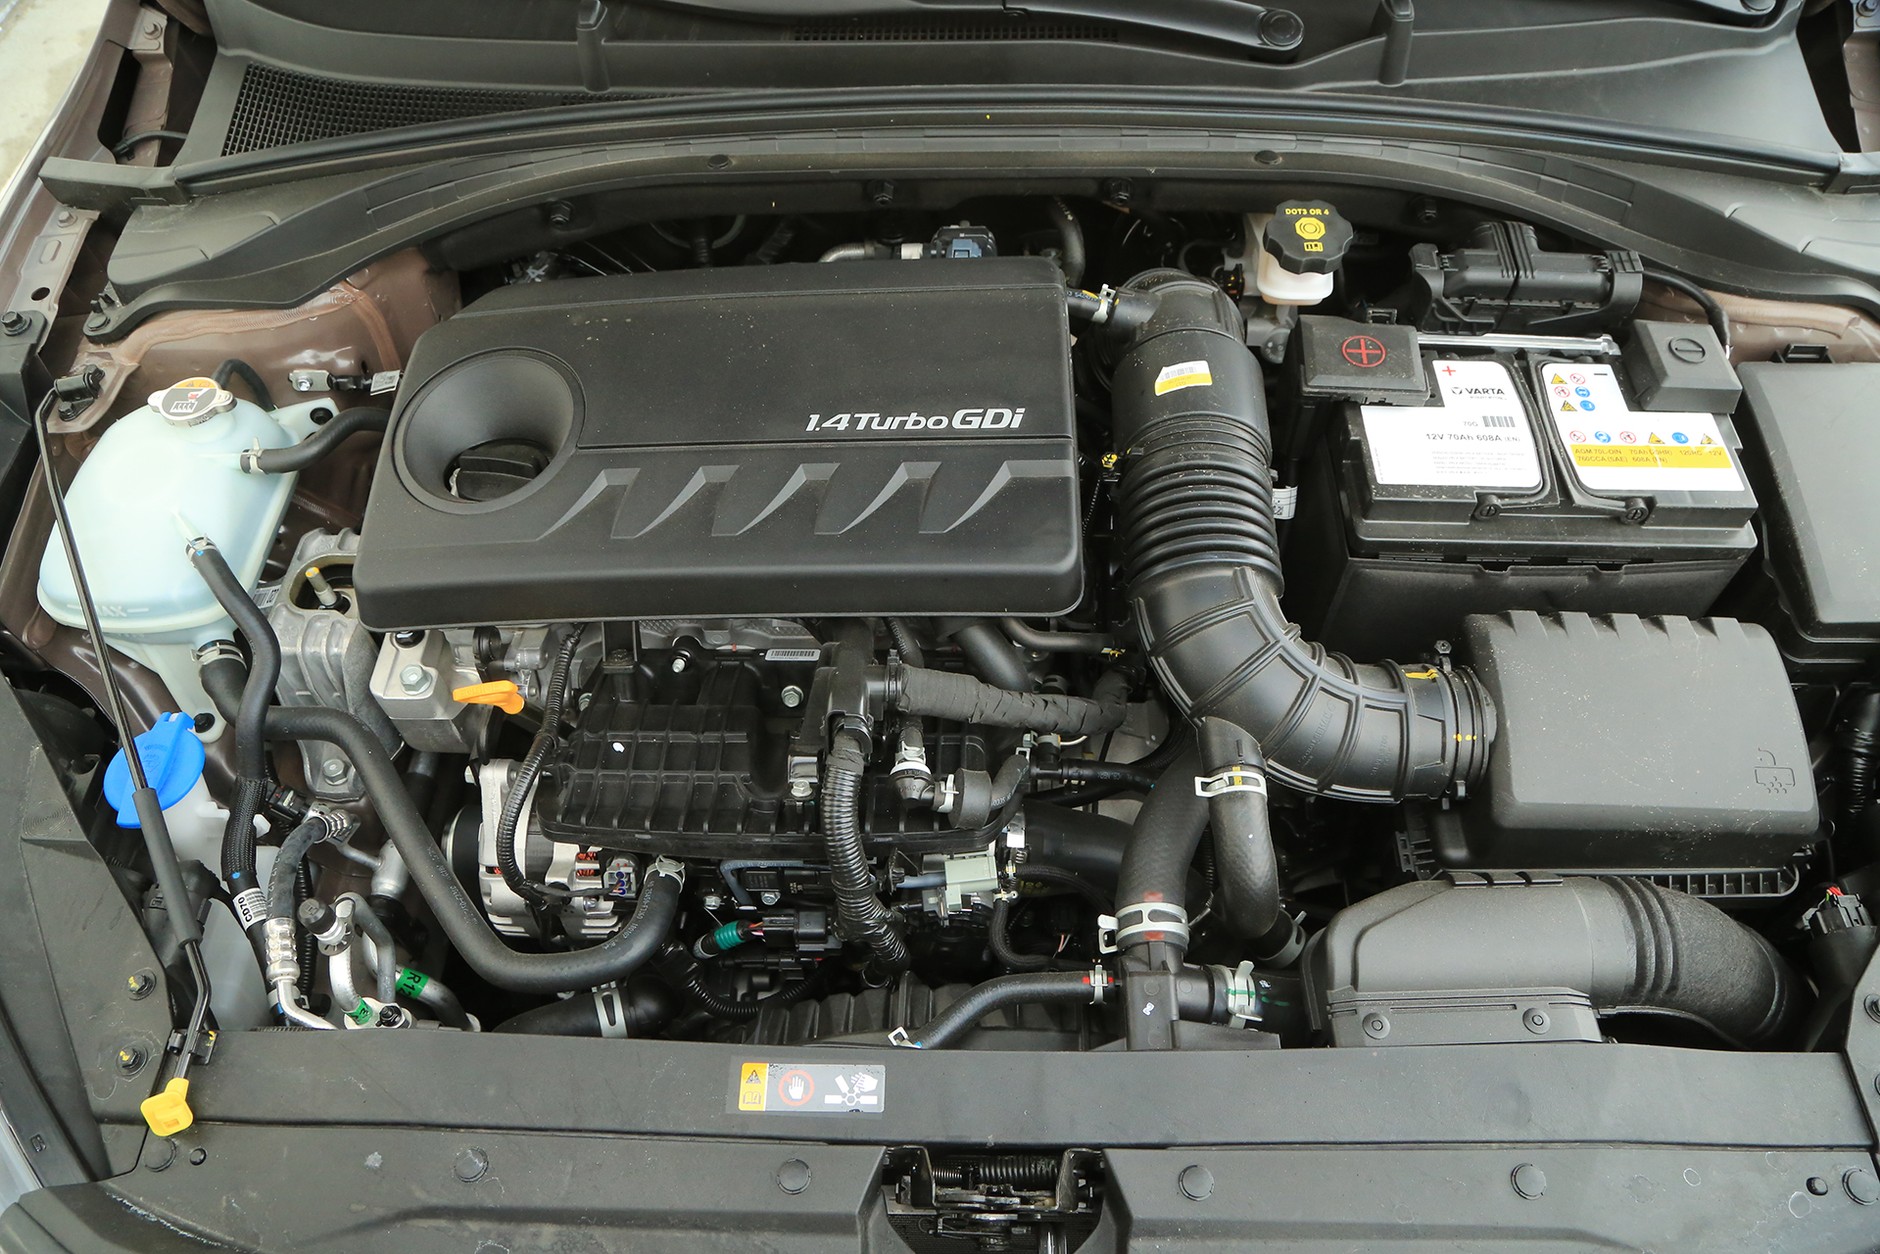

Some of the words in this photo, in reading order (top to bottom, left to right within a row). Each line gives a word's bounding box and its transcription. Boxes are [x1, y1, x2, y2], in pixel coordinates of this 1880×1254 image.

[1465, 387, 1505, 395] VARTA
[805, 413, 851, 431] 1.4
[854, 412, 948, 430] Turbo
[951, 408, 1026, 429] GDi
[1476, 434, 1502, 442] 608A
[238, 897, 252, 922] CD70
